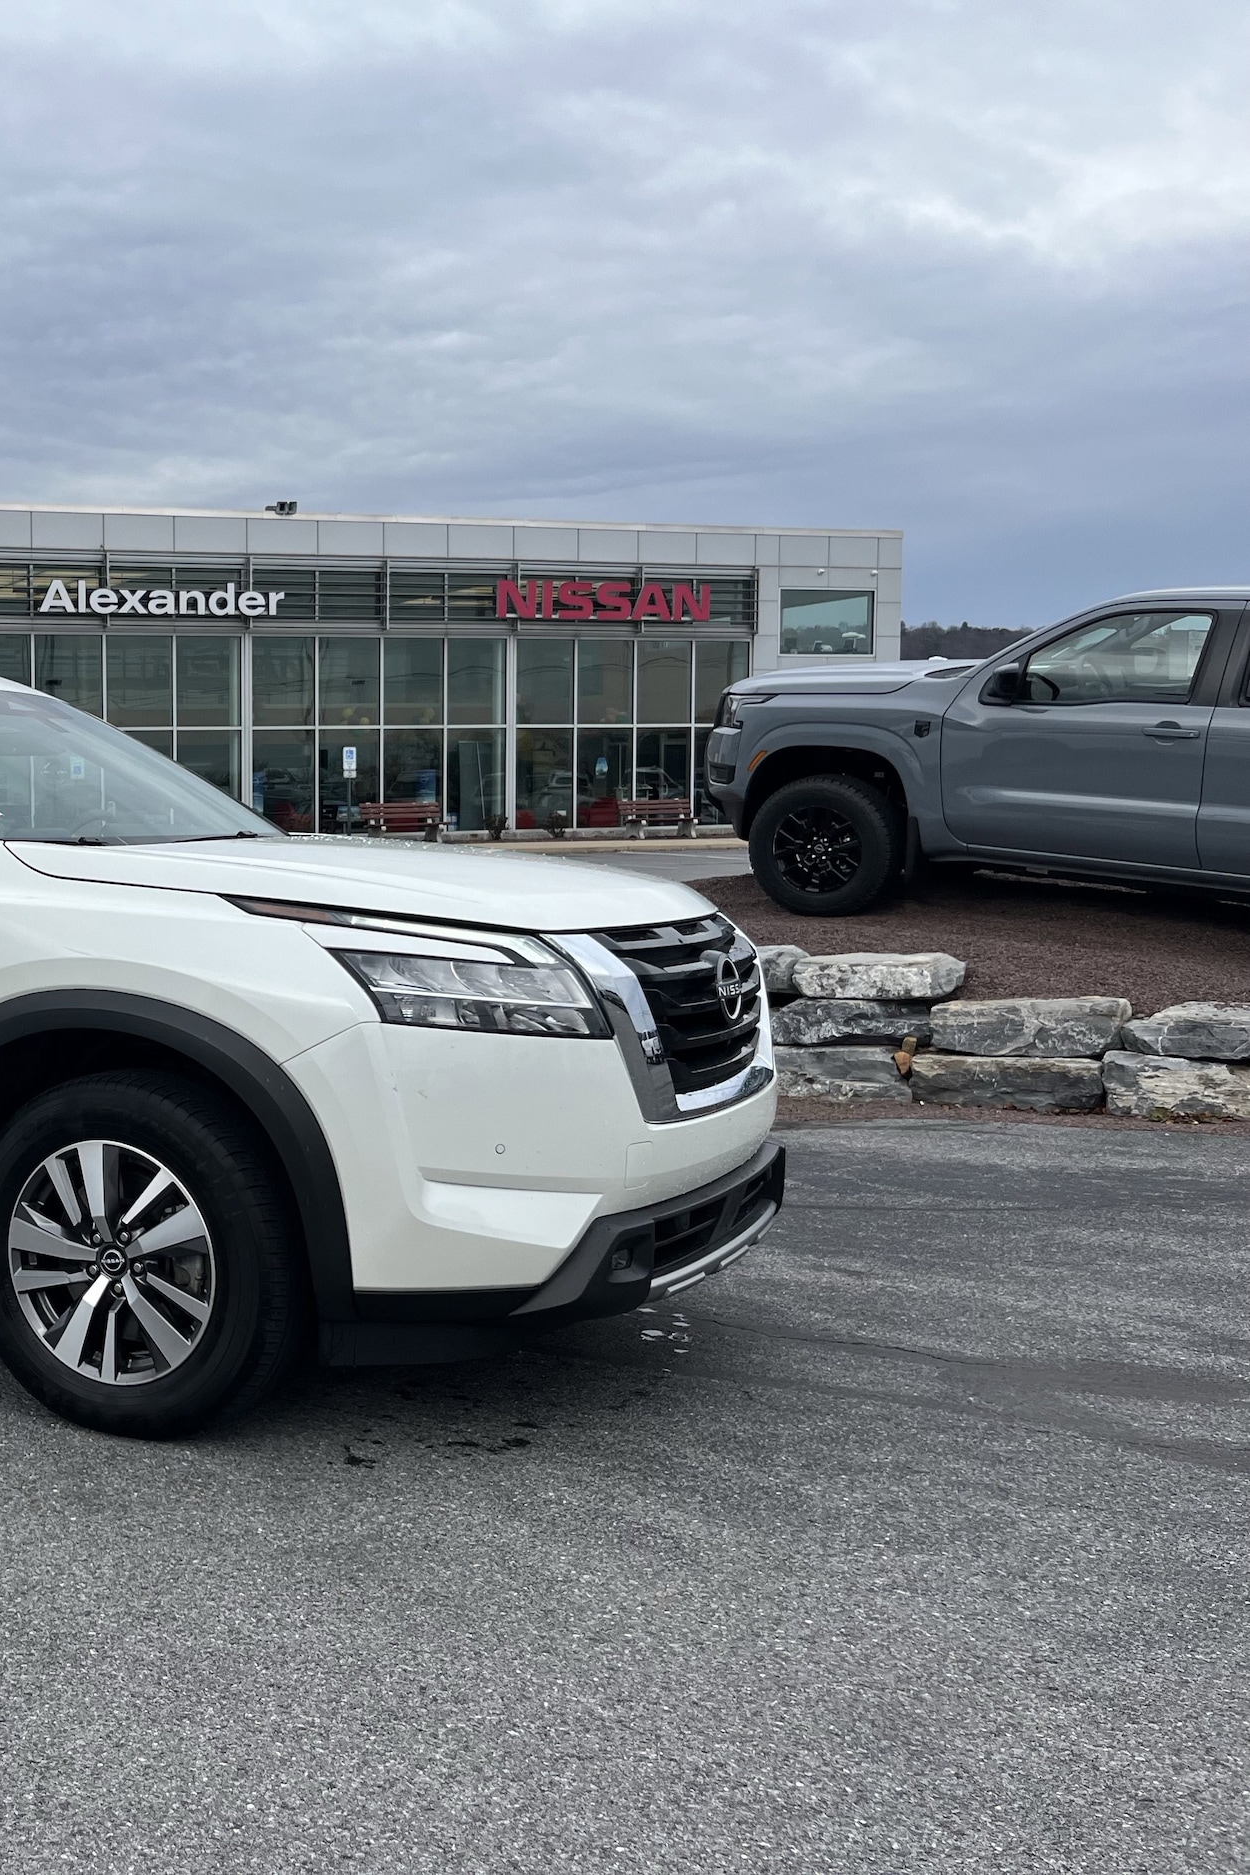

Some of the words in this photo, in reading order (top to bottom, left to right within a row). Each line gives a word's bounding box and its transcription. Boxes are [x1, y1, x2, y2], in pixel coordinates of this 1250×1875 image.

[39, 579, 285, 616] Alexander
[496, 579, 711, 622] NISSAN
[718, 984, 740, 997] NISS
